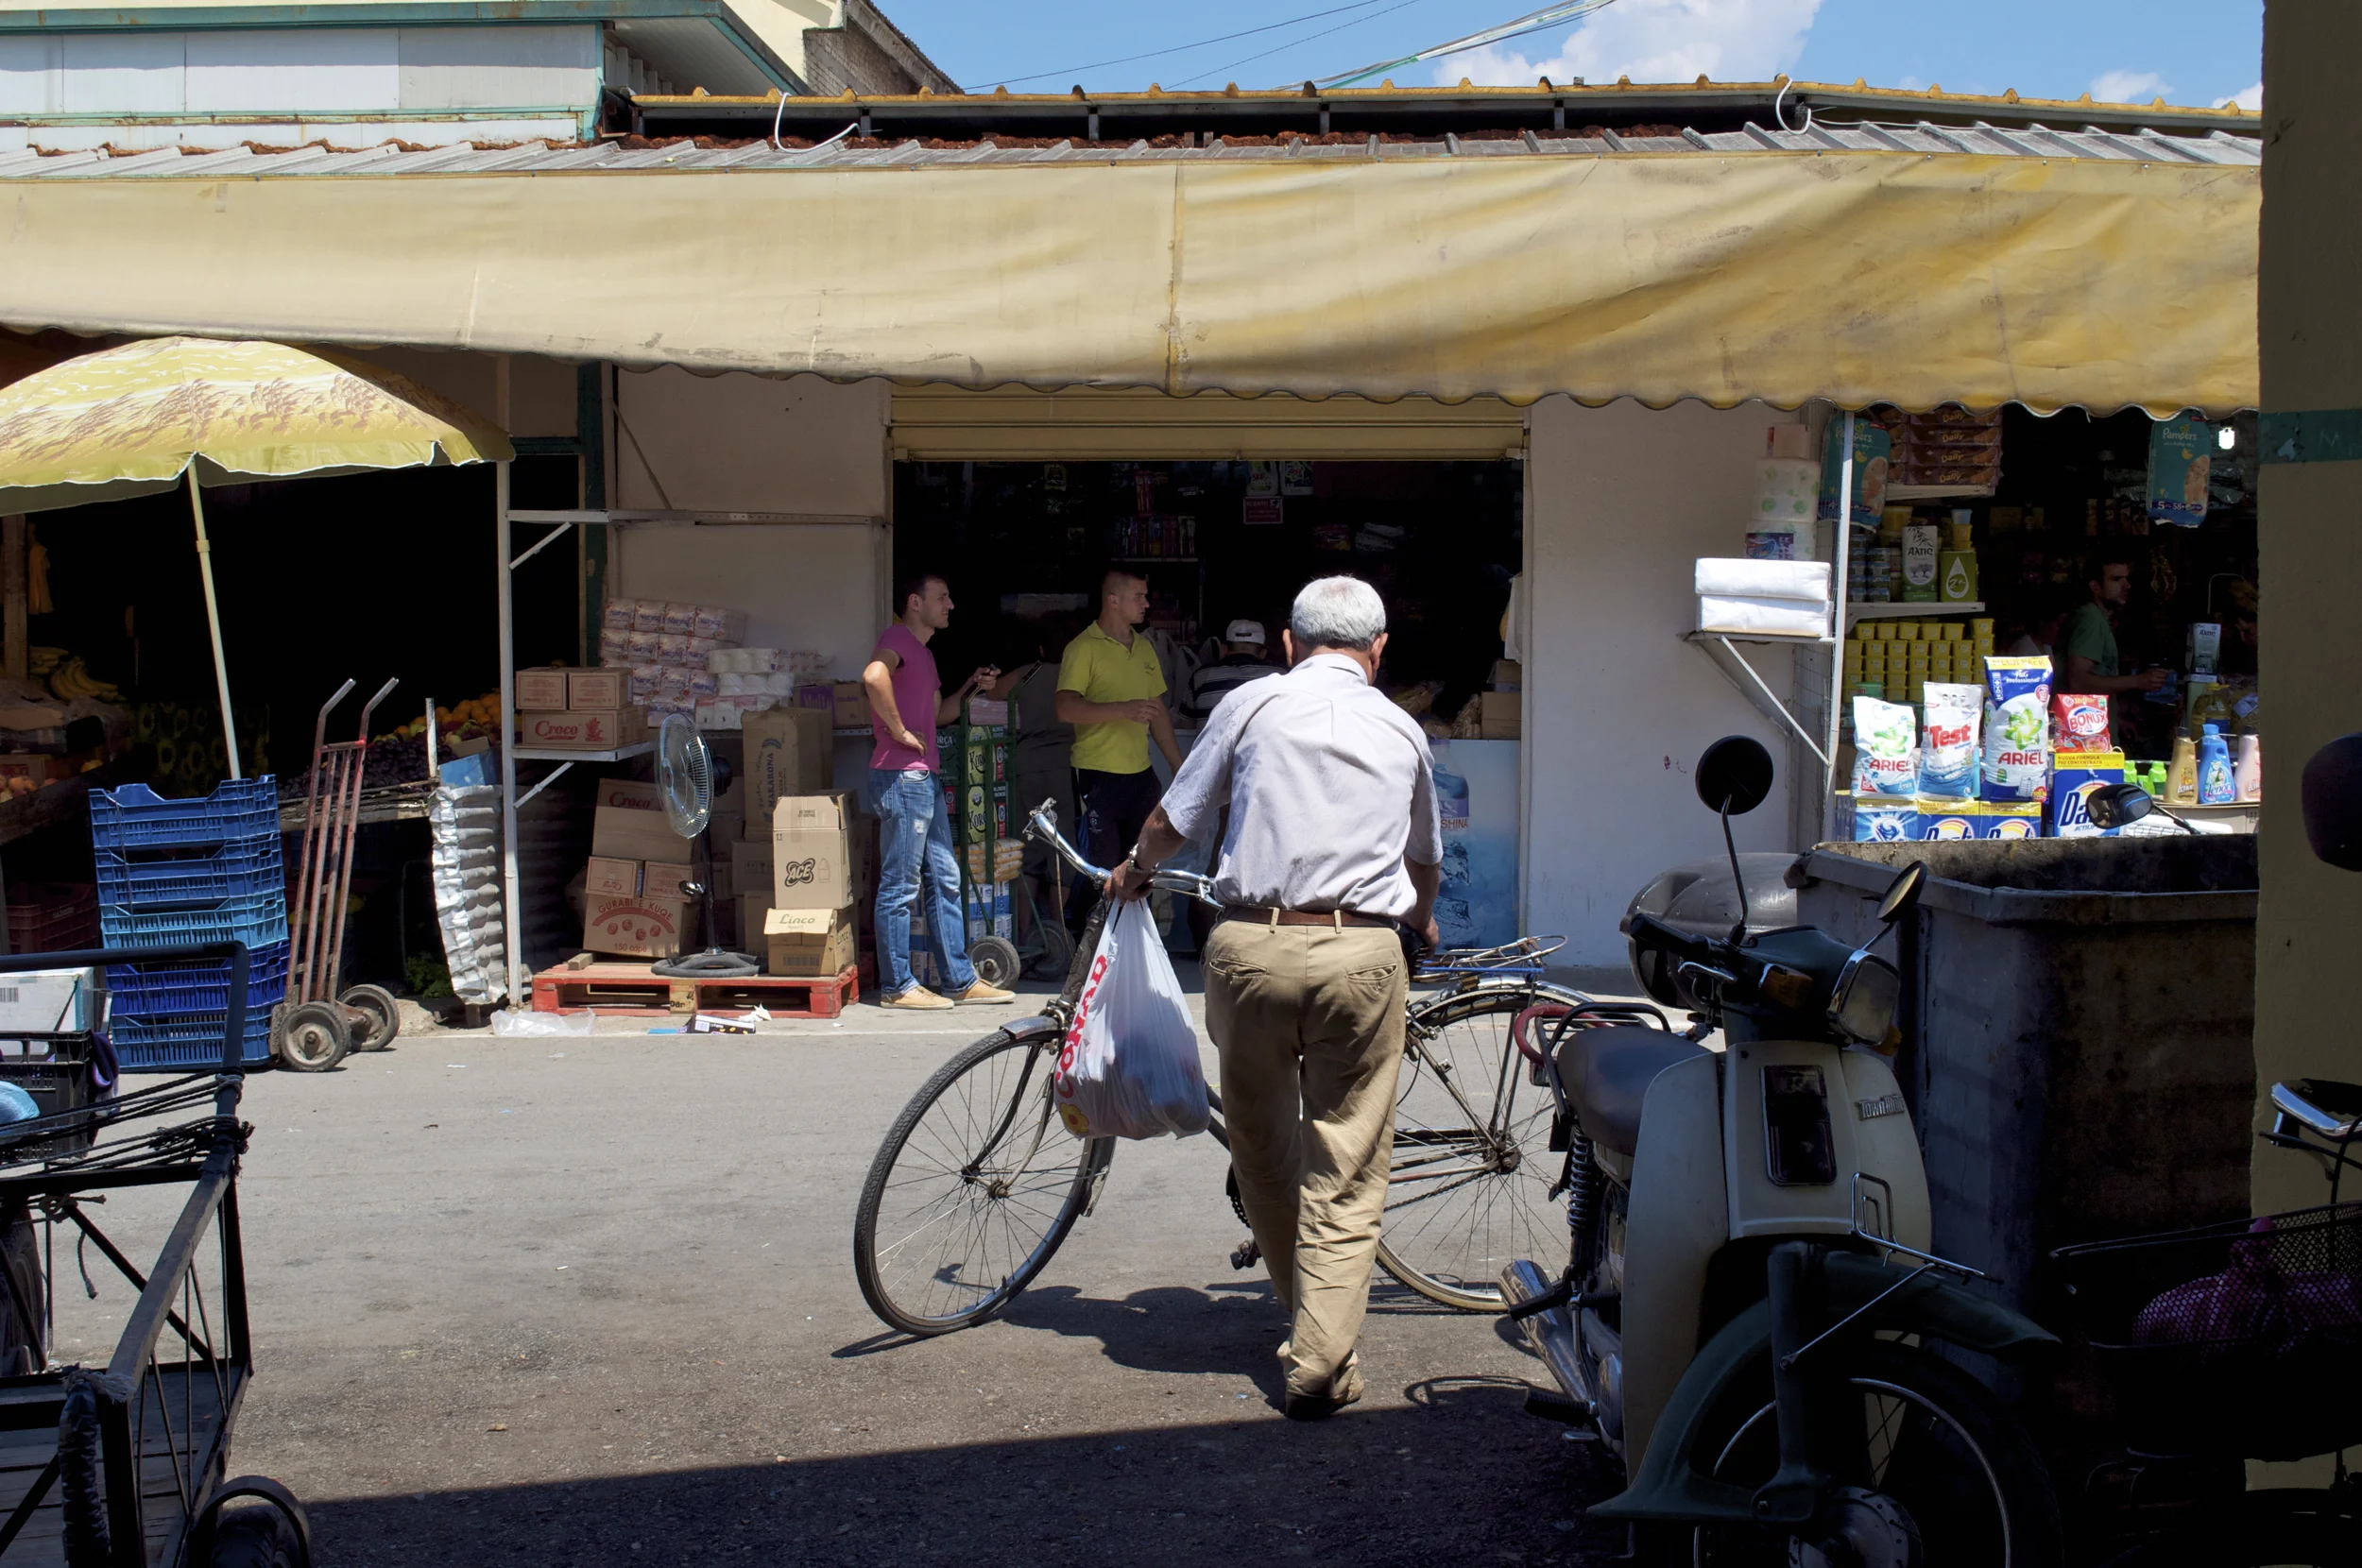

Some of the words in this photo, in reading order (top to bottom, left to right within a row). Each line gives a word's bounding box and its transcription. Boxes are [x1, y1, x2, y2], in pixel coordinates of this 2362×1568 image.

[1836, 426, 1873, 442] Papers
[2163, 427, 2198, 441] Pampers
[2158, 501, 2165, 509] 5
[535, 721, 578, 737] Croco
[2070, 712, 2107, 730] BONUX
[1929, 724, 1971, 749] Test
[1869, 758, 1911, 773] ARIEL
[1998, 752, 2044, 765] ARIEL
[767, 753, 776, 808] MAKARONA
[609, 791, 650, 809] Croco
[788, 864, 811, 880] ACE
[598, 898, 633, 913] GURABI
[639, 899, 643, 908] E
[649, 902, 674, 921] KUQE
[779, 913, 815, 925] Linco
[614, 943, 627, 952] 150
